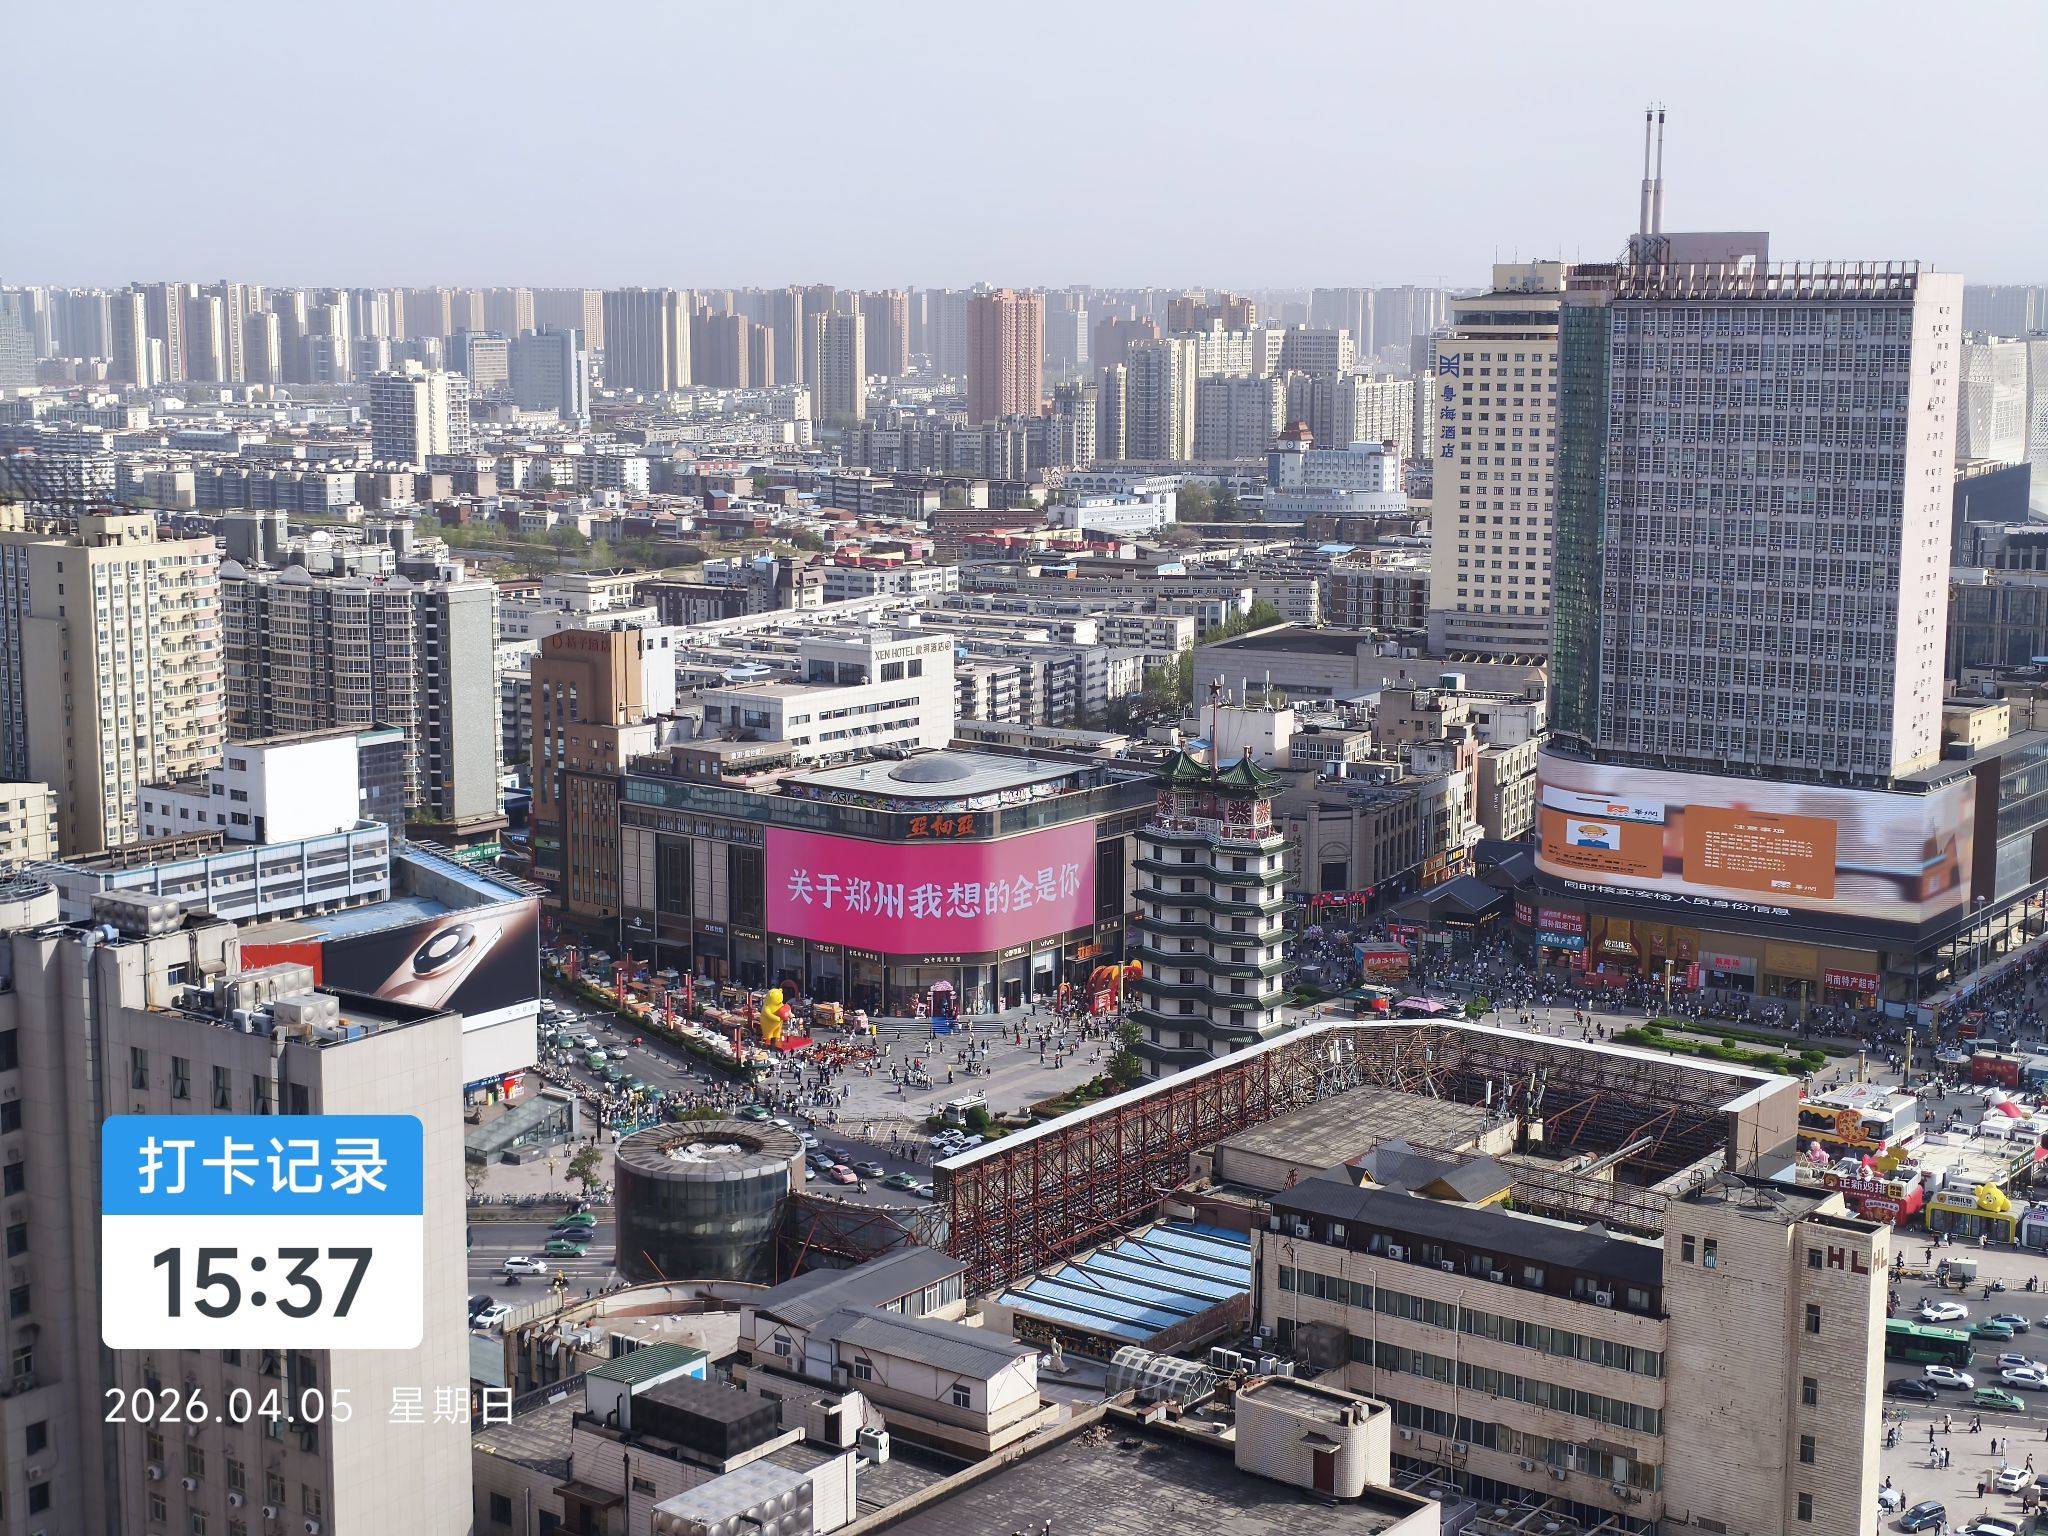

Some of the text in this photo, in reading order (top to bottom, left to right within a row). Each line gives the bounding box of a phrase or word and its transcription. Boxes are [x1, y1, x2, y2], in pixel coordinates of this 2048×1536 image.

[1440, 385, 1456, 458] 粤海酒店
[875, 649, 891, 660] XEN
[892, 645, 915, 659] HOTEL
[787, 863, 1081, 920] 关于郑州我想的全是你
[1041, 939, 1055, 947] vivo
[1825, 973, 1876, 990] 河南特产超市
[1840, 1178, 1887, 1194] 正新鸡排
[1827, 1245, 1888, 1276] HL HL
